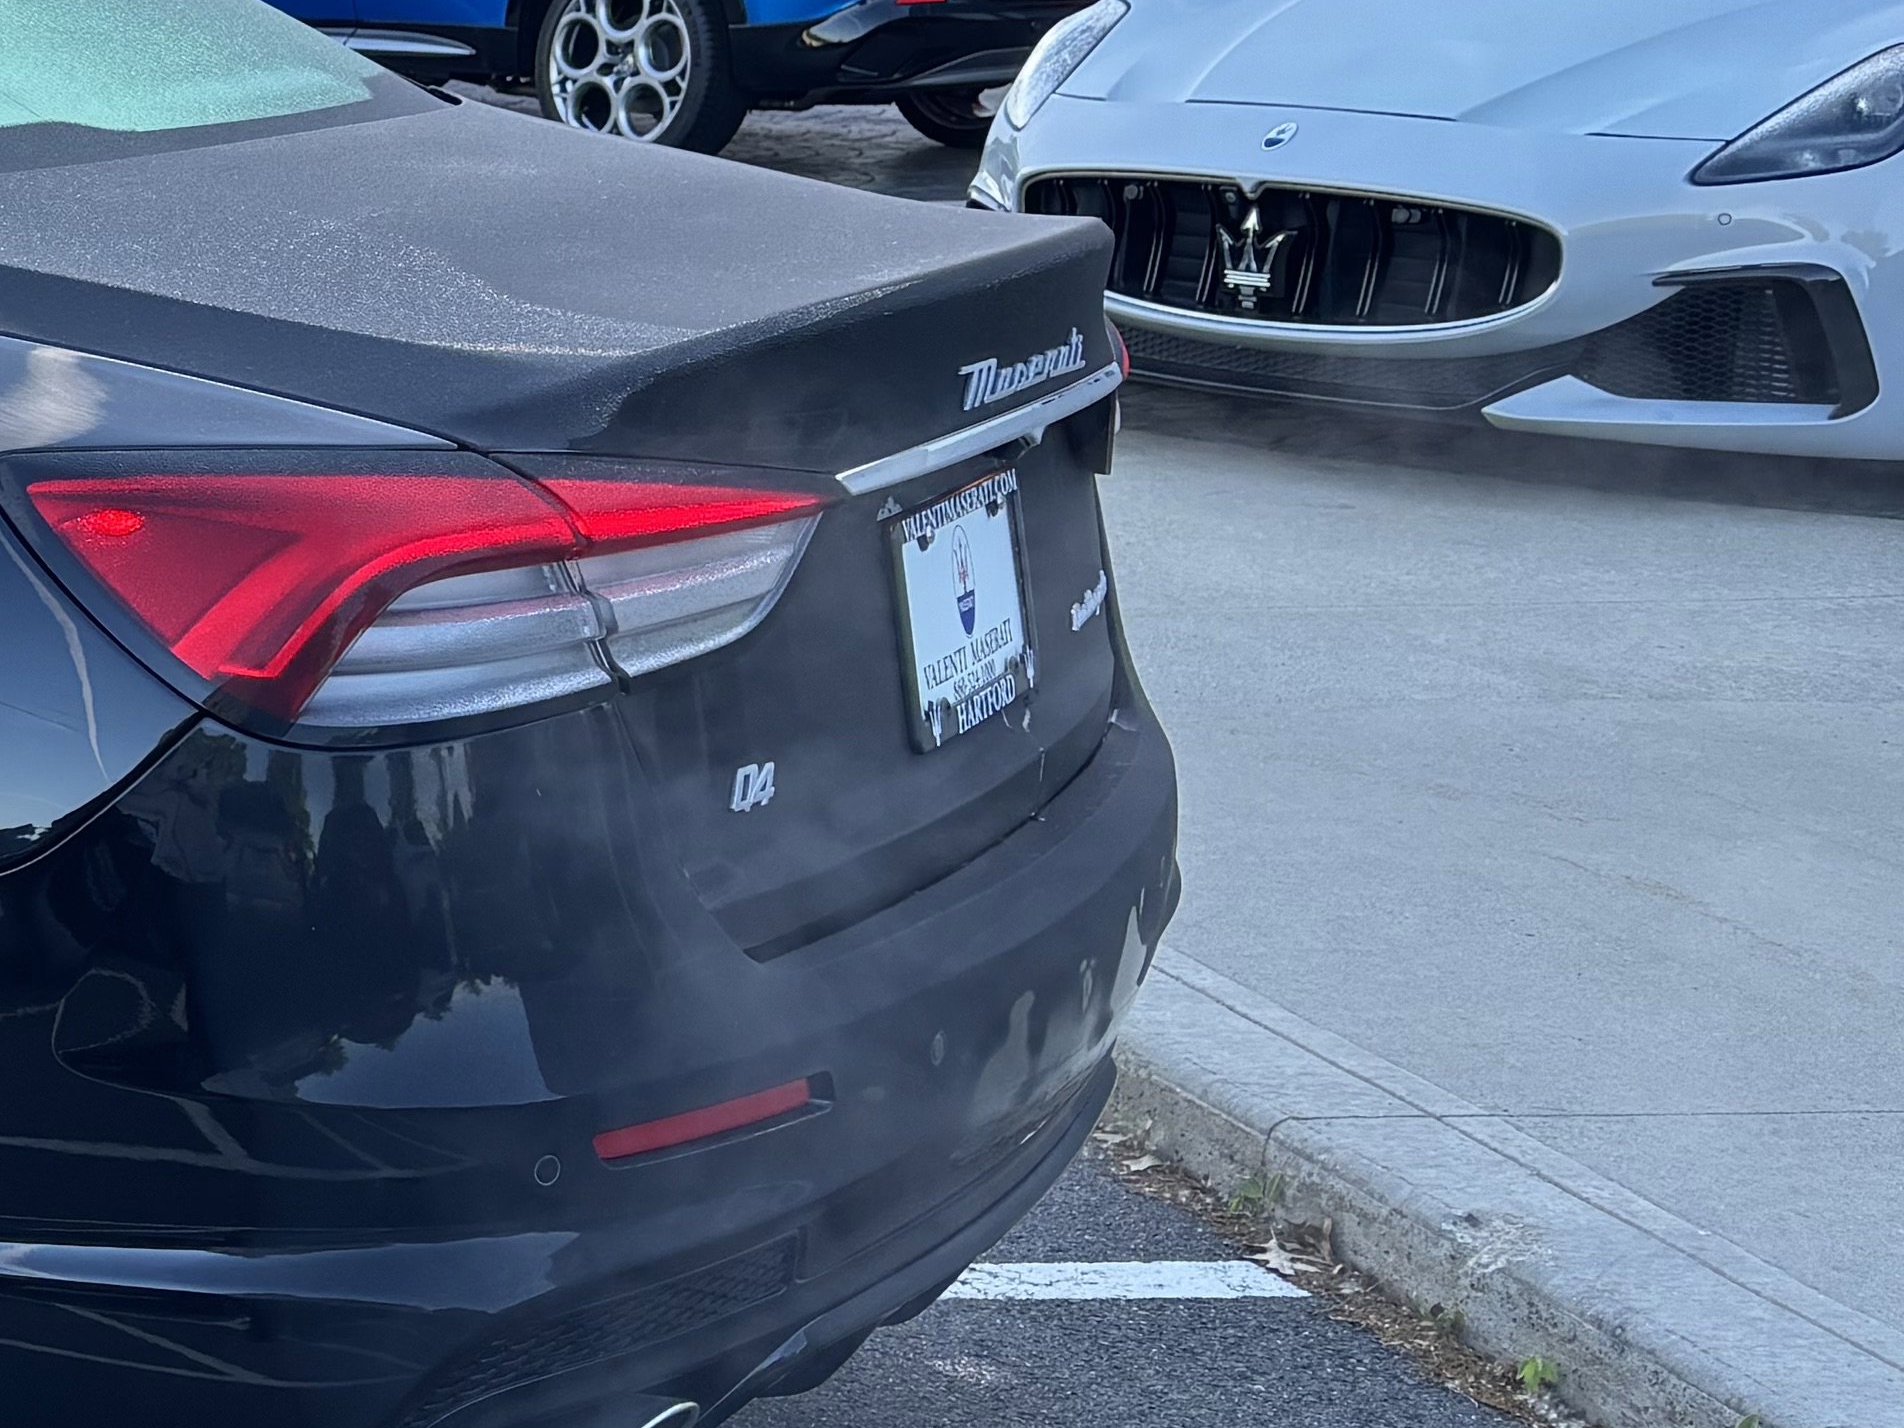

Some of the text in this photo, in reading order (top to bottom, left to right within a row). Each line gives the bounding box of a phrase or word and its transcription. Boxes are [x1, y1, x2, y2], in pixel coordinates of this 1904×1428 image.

[958, 327, 1086, 410] Maserati
[923, 646, 968, 690] VALENTI
[970, 618, 1014, 666] MASERATI
[955, 674, 1016, 734] HARTFORD
